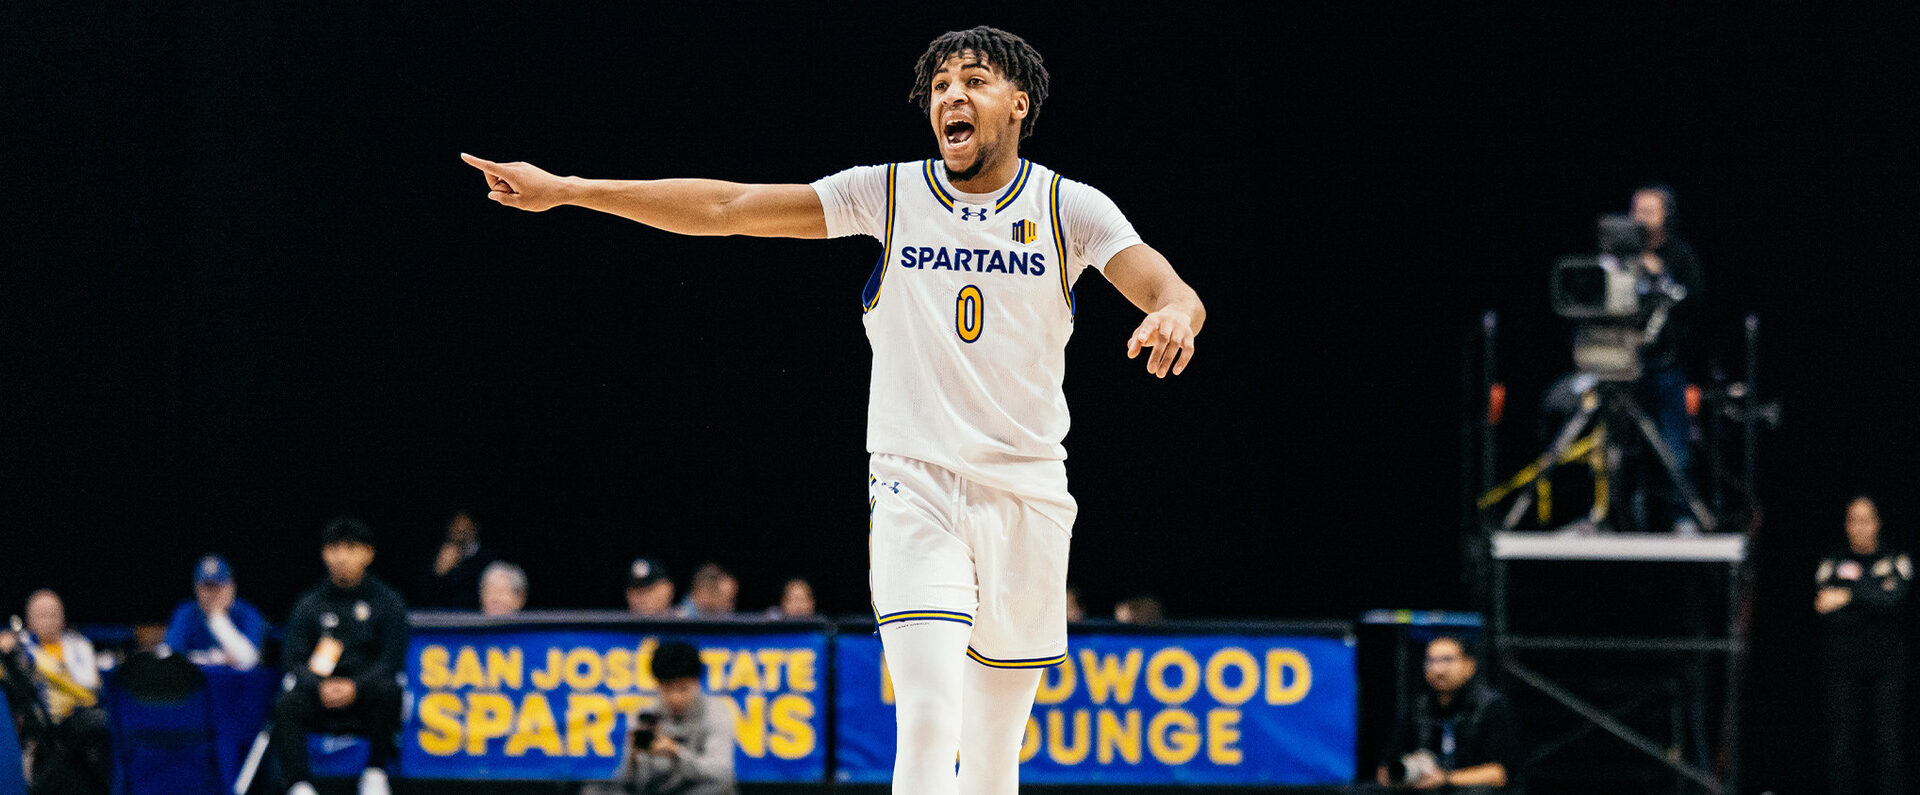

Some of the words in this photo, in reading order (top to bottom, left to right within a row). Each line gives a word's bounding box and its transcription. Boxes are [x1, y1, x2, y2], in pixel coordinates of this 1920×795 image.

[901, 246, 1045, 276] SPARTANS
[956, 284, 984, 343] 0
[420, 645, 523, 690] SAN
[699, 648, 816, 692] TATE
[418, 693, 816, 759] SPARNS
[1017, 708, 1243, 765] UNGE
